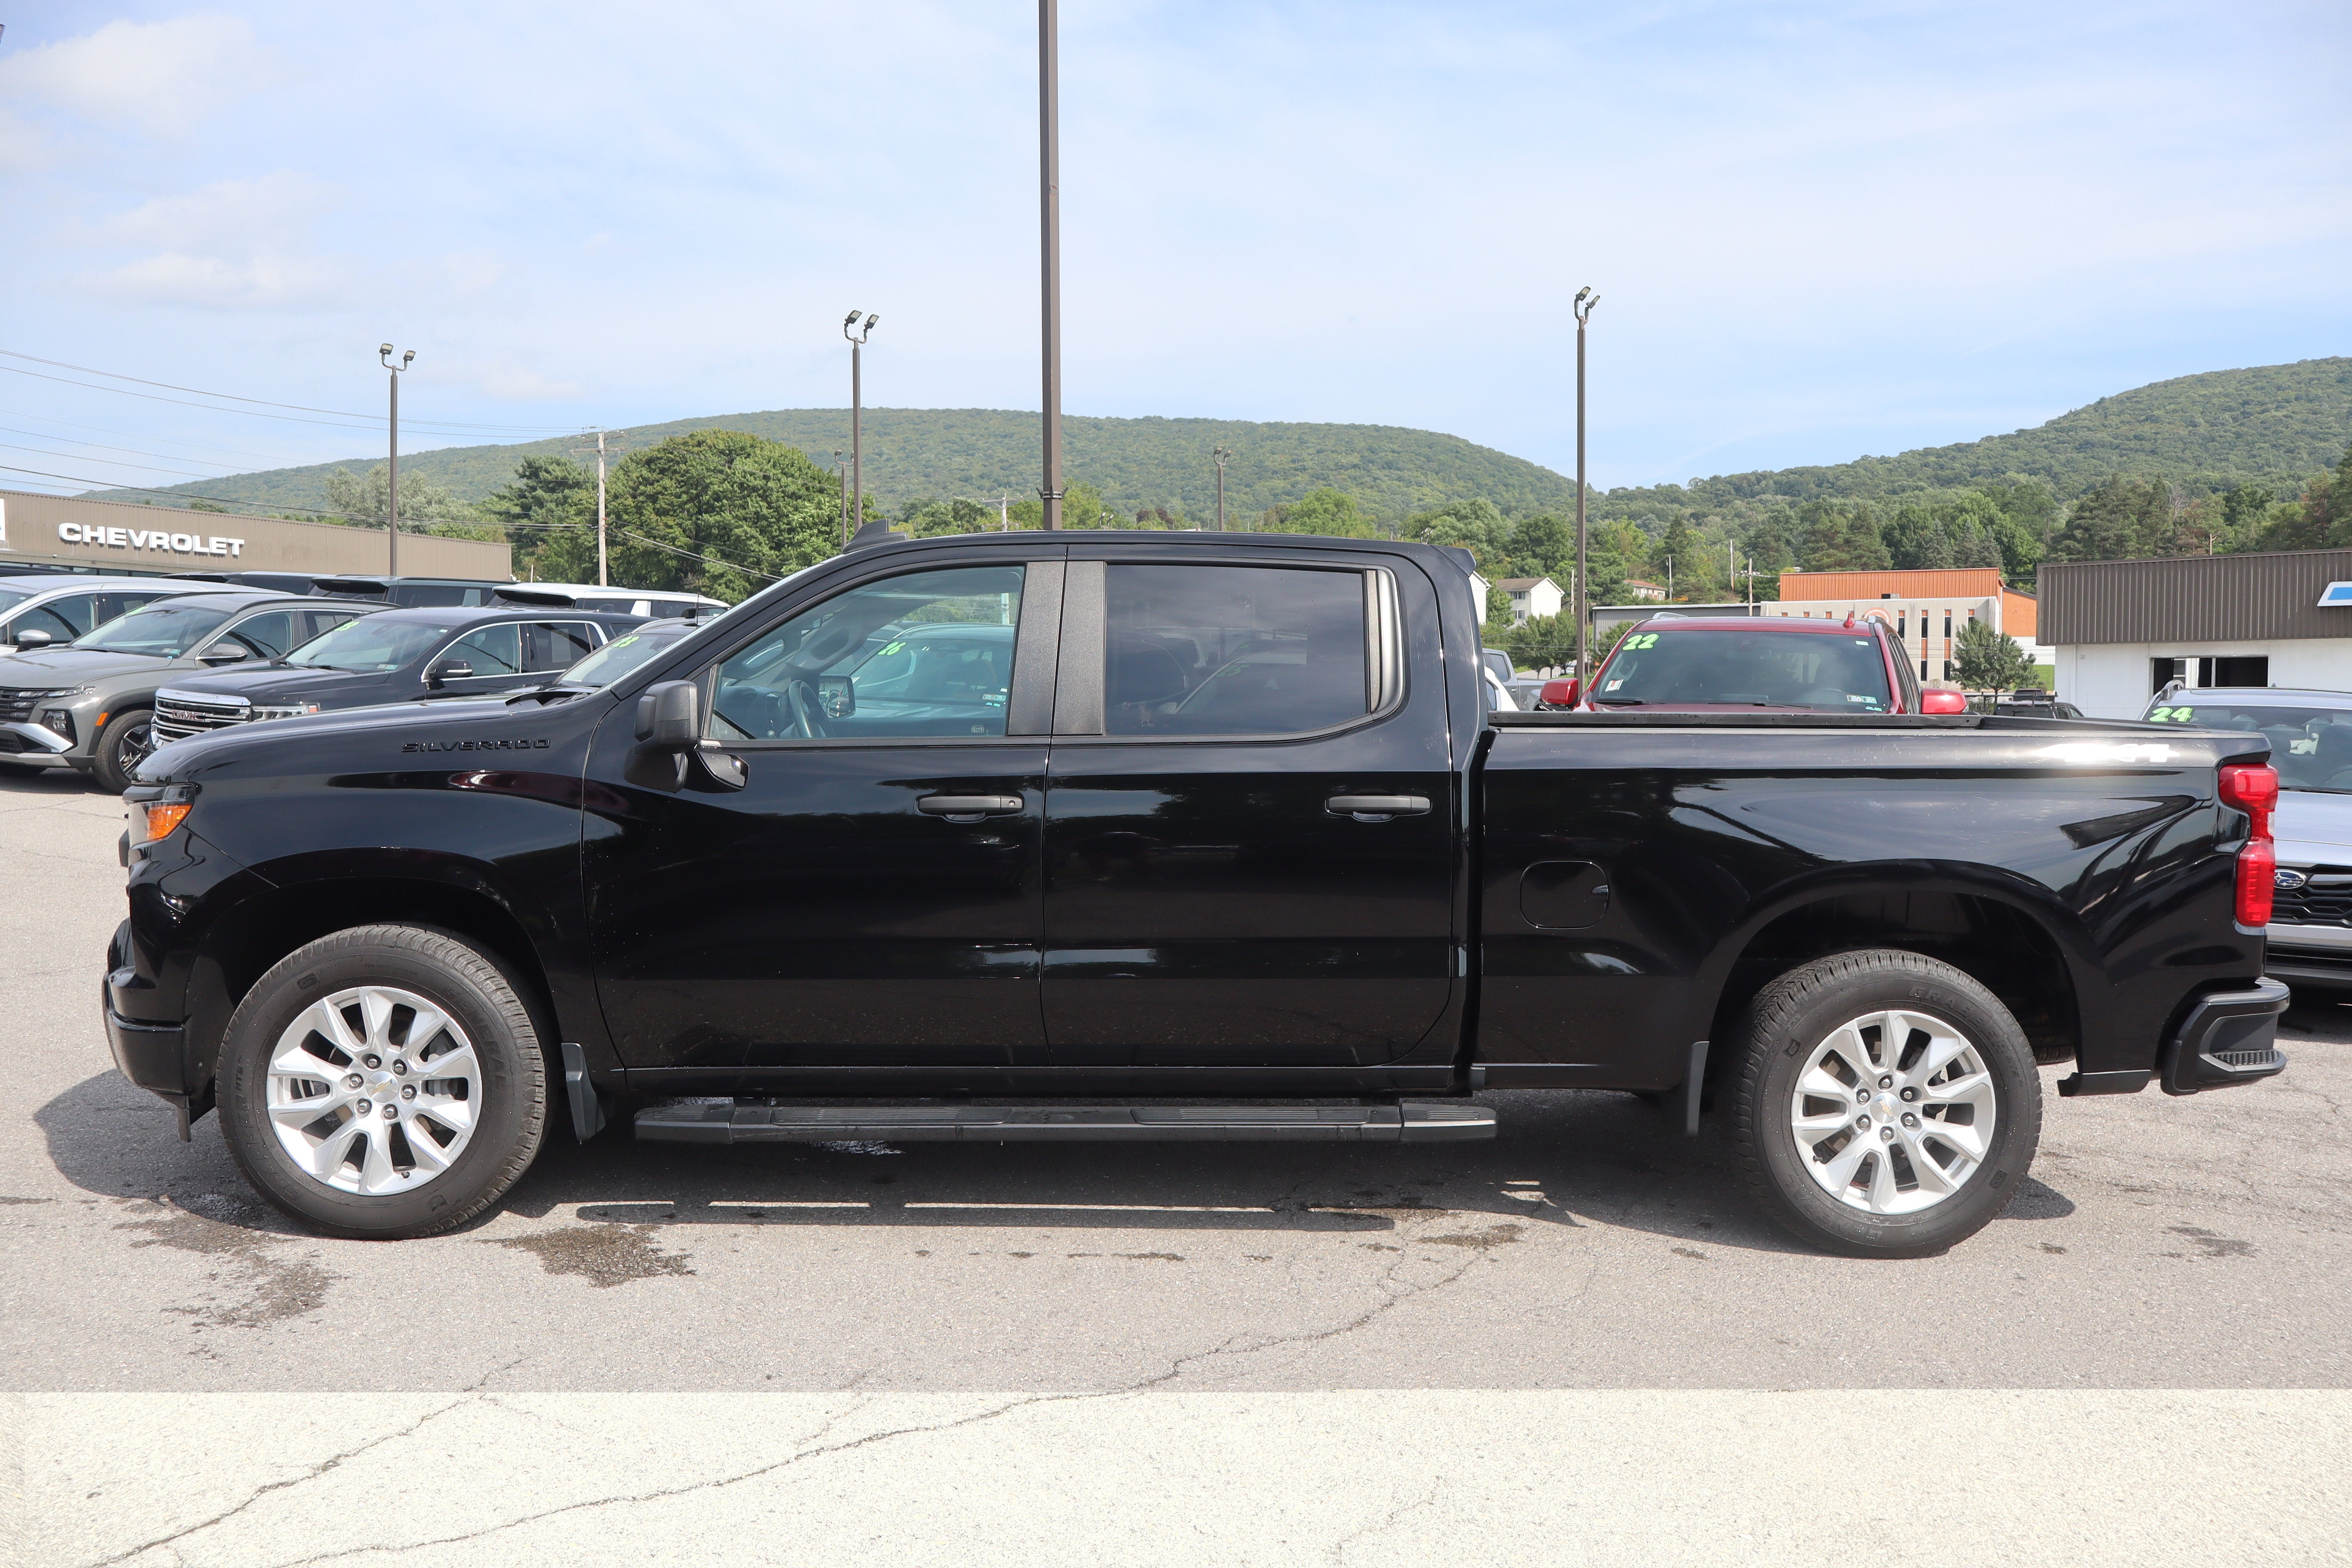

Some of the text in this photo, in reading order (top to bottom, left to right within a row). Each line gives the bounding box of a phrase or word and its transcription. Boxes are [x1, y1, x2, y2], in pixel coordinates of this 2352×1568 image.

[59, 522, 245, 556] CHEVROLET
[878, 641, 906, 655] 26
[1622, 633, 1659, 650] 22
[172, 710, 205, 722] GMC
[2149, 707, 2193, 722] 24
[402, 739, 550, 753] SILVERADO
[1908, 985, 2009, 1054] GRABBER
[445, 989, 508, 1090] GENERAL
[235, 1094, 303, 1201] GRABBER
[1786, 1174, 1882, 1241] GENERAL
